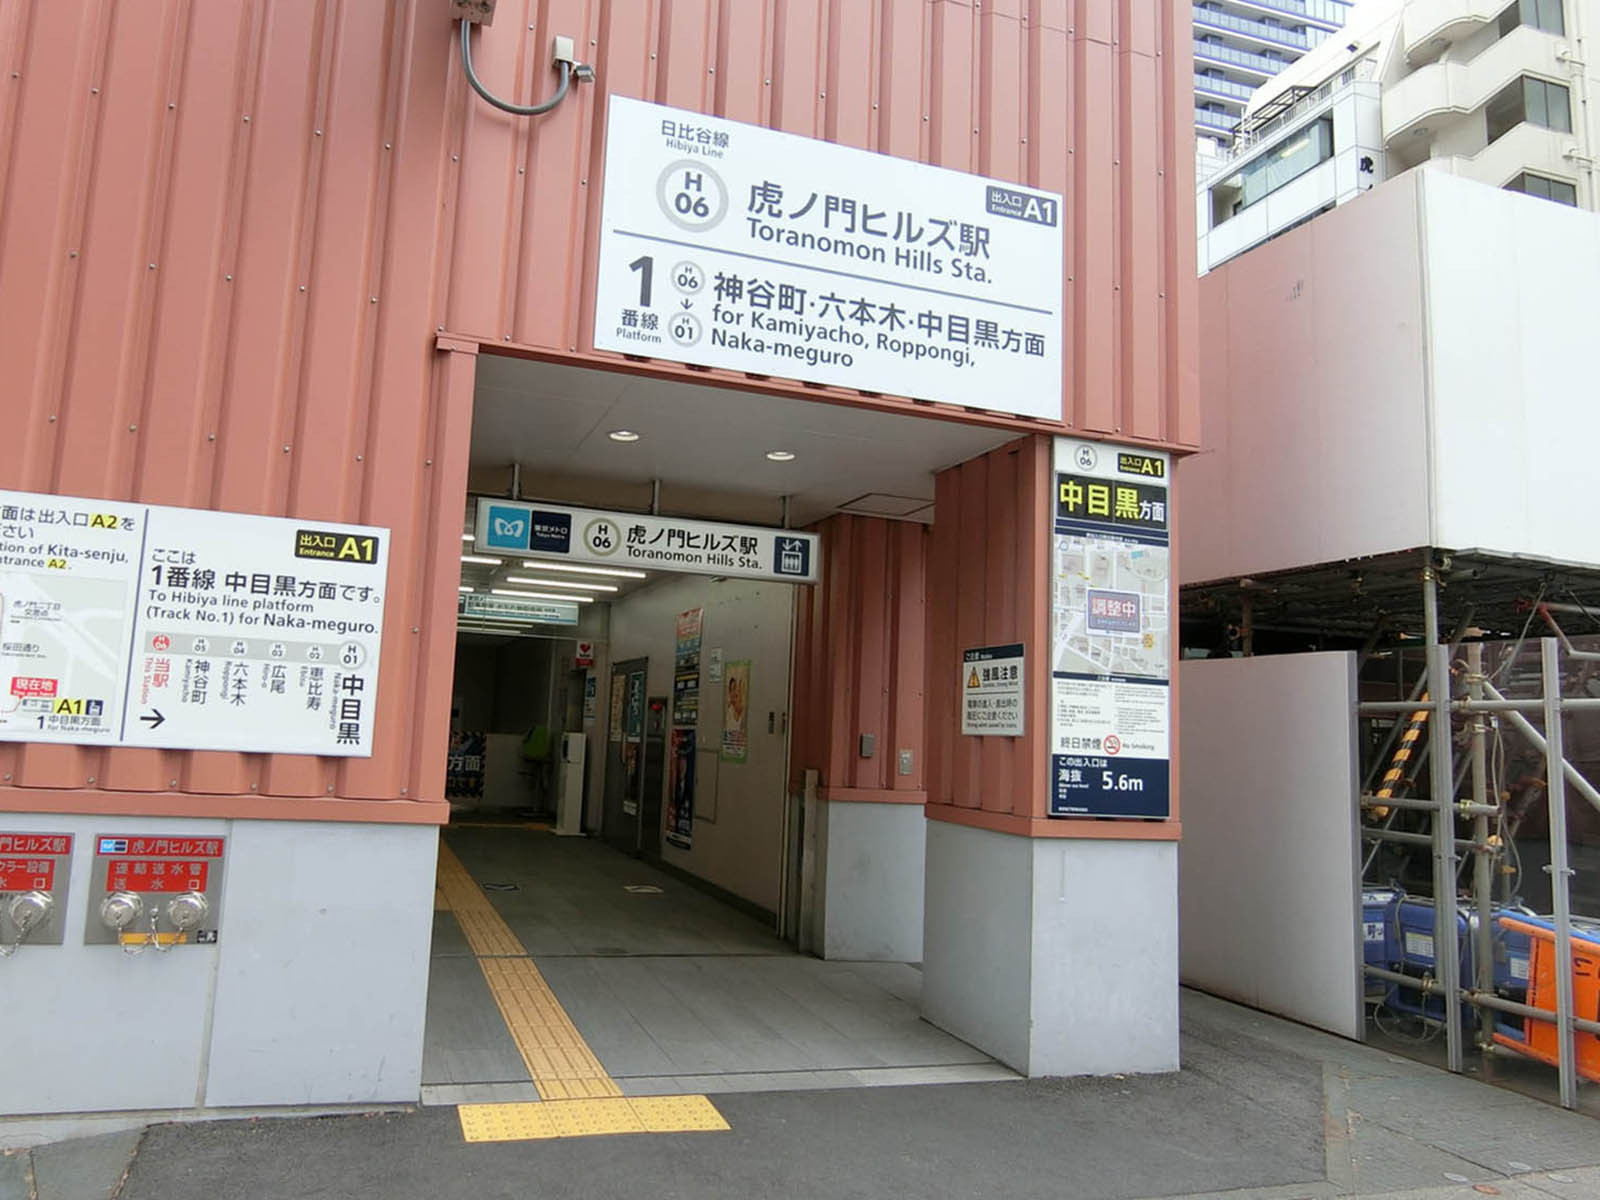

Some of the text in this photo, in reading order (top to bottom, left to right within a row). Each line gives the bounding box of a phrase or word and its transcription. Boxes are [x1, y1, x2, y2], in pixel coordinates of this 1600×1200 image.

[661, 119, 729, 148] 日比谷線
[666, 138, 724, 159] Hibiya Line
[684, 171, 702, 192] H
[674, 192, 709, 217] 06
[991, 190, 1022, 207] 出入口
[747, 180, 990, 259] 虎ノ門ヒルズ駅
[991, 203, 1022, 217] Entrance
[1023, 197, 1053, 223] A1
[746, 216, 992, 284] Toranomon Hills Sta.
[629, 255, 653, 307] 1
[677, 273, 698, 289] 06
[684, 266, 693, 275] H
[621, 308, 659, 331] 番線
[682, 317, 690, 325] H
[616, 327, 661, 344] Platform
[674, 325, 693, 340] 01
[712, 303, 975, 368] for Kamiyacho, Roppongi,
[711, 329, 854, 367] Naka-meguro
[1079, 456, 1092, 466] 06
[1140, 458, 1162, 476] A1
[1060, 480, 1165, 522] 中目黒方面
[0, 523, 34, 539] さい
[299, 533, 336, 548] 出入口
[598, 525, 608, 535] H
[627, 525, 758, 555] 虎ノ門ヒルズ駅
[299, 547, 335, 558] Entrance
[338, 536, 374, 562] A1
[592, 536, 611, 548] 06
[29, 544, 43, 554] of
[47, 544, 129, 564] Kita-senju,
[152, 548, 197, 565] ここは
[626, 545, 762, 569] Toranomon Hills Sta.
[151, 565, 381, 603] 1番線 中目黒方面です。
[148, 589, 314, 613] To Hibiya line platform
[146, 606, 379, 635] (Track No.1) for Naka-meguro.
[271, 649, 283, 657] 03
[309, 652, 321, 660] 02
[343, 654, 358, 664] 01
[347, 645, 356, 654] H
[152, 657, 170, 688] 当駅
[191, 660, 210, 705] 神谷町
[270, 664, 287, 694] 広尾
[16, 679, 54, 690] 現在地
[230, 662, 249, 707] 六本木
[306, 667, 324, 711] 恵比寿
[57, 699, 82, 715] A1
[336, 674, 364, 745] 中目黒
[37, 716, 45, 729] 1
[1102, 770, 1143, 791] 5.6m
[132, 839, 219, 854] 虎ノ門ヒルズ駅
